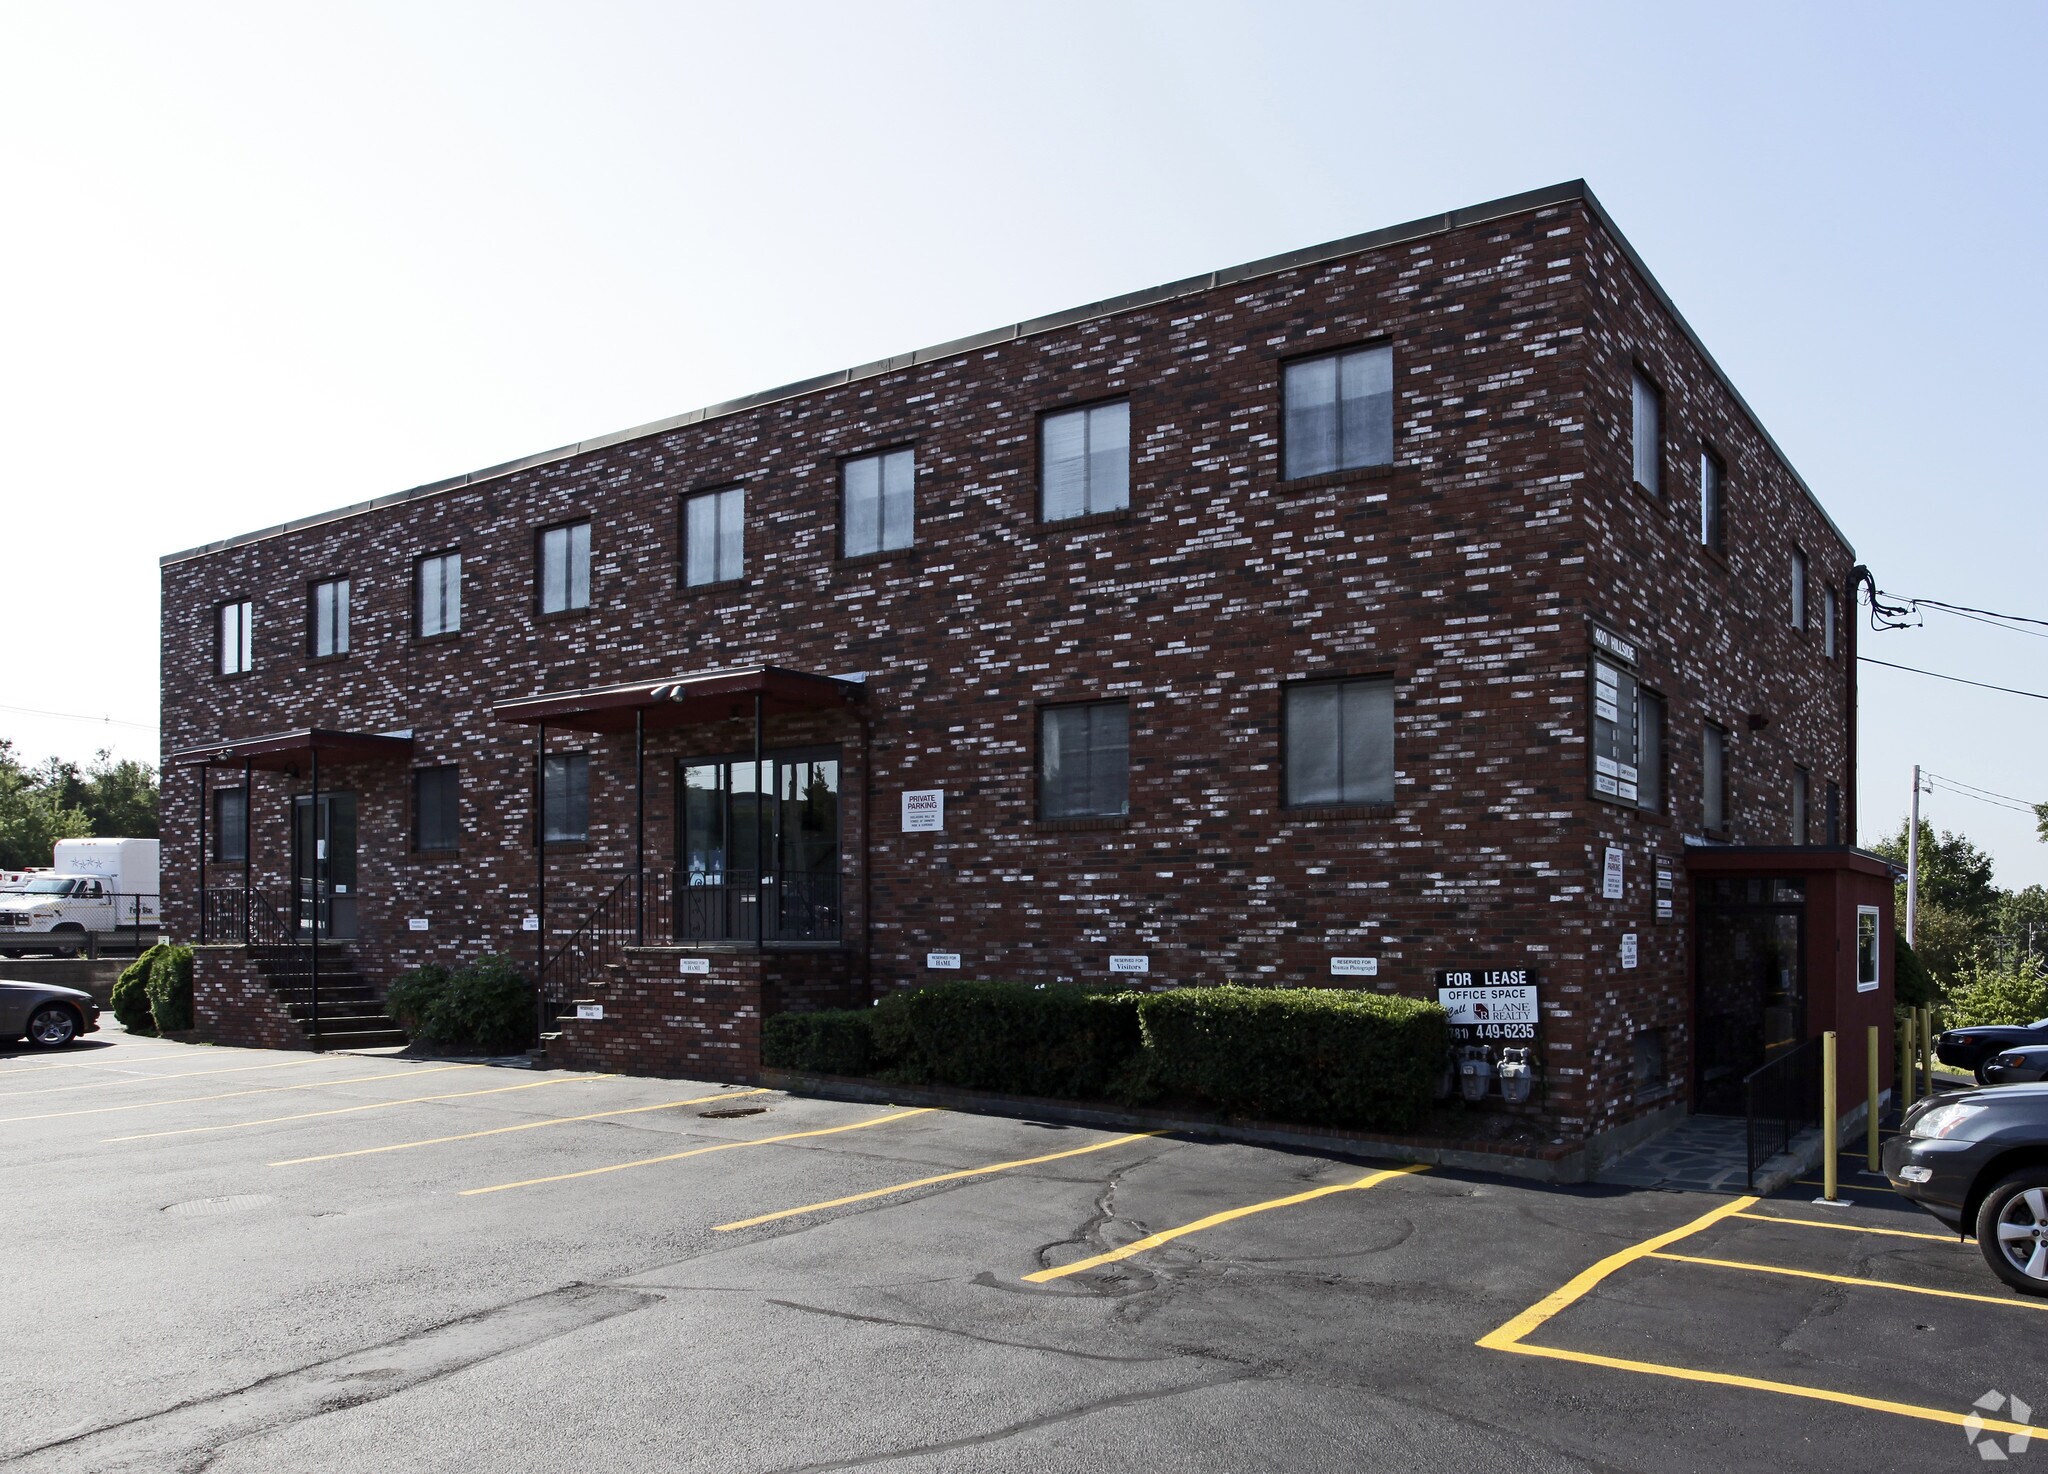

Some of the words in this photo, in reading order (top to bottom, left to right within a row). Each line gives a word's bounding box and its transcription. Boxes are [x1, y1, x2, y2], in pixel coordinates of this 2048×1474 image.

[1595, 628, 1608, 646] 400
[1611, 636, 1635, 661] HILLSIDE
[907, 802, 937, 810] PARKING
[1446, 972, 1472, 986] FOR
[1484, 970, 1527, 985] LEASE
[1448, 990, 1486, 1000] OFFICE
[1491, 989, 1526, 999] SPACE
[1447, 1004, 1466, 1018] Call
[1492, 1003, 1530, 1011] LANE
[1492, 1012, 1530, 1020] REALTY
[1476, 1024, 1534, 1039] 449-6235
